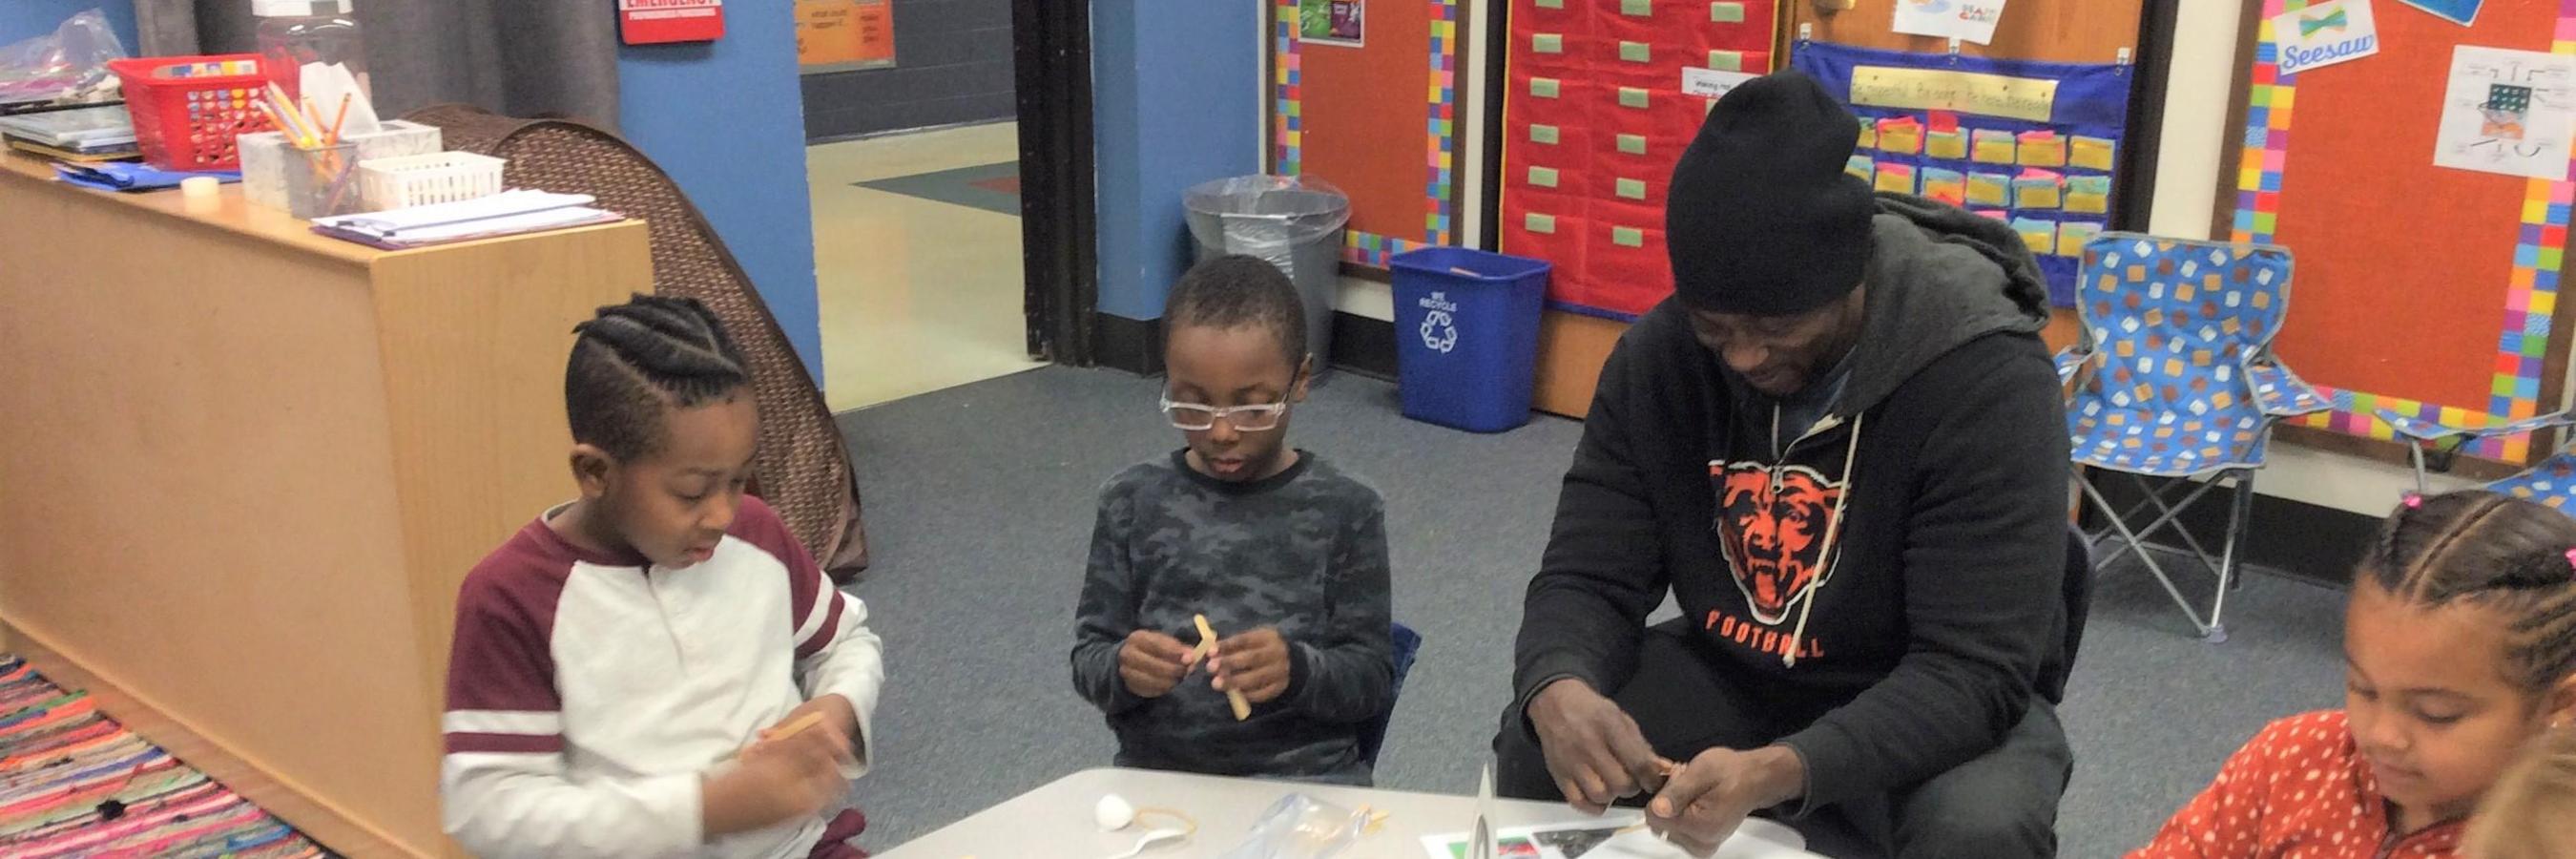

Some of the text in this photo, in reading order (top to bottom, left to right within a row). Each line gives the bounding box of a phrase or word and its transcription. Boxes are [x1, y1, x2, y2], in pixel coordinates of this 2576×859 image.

[2282, 34, 2375, 70] Seesaw
[1419, 297, 1458, 312] RECYCLE
[1705, 610, 1824, 659] FOOTBALL
